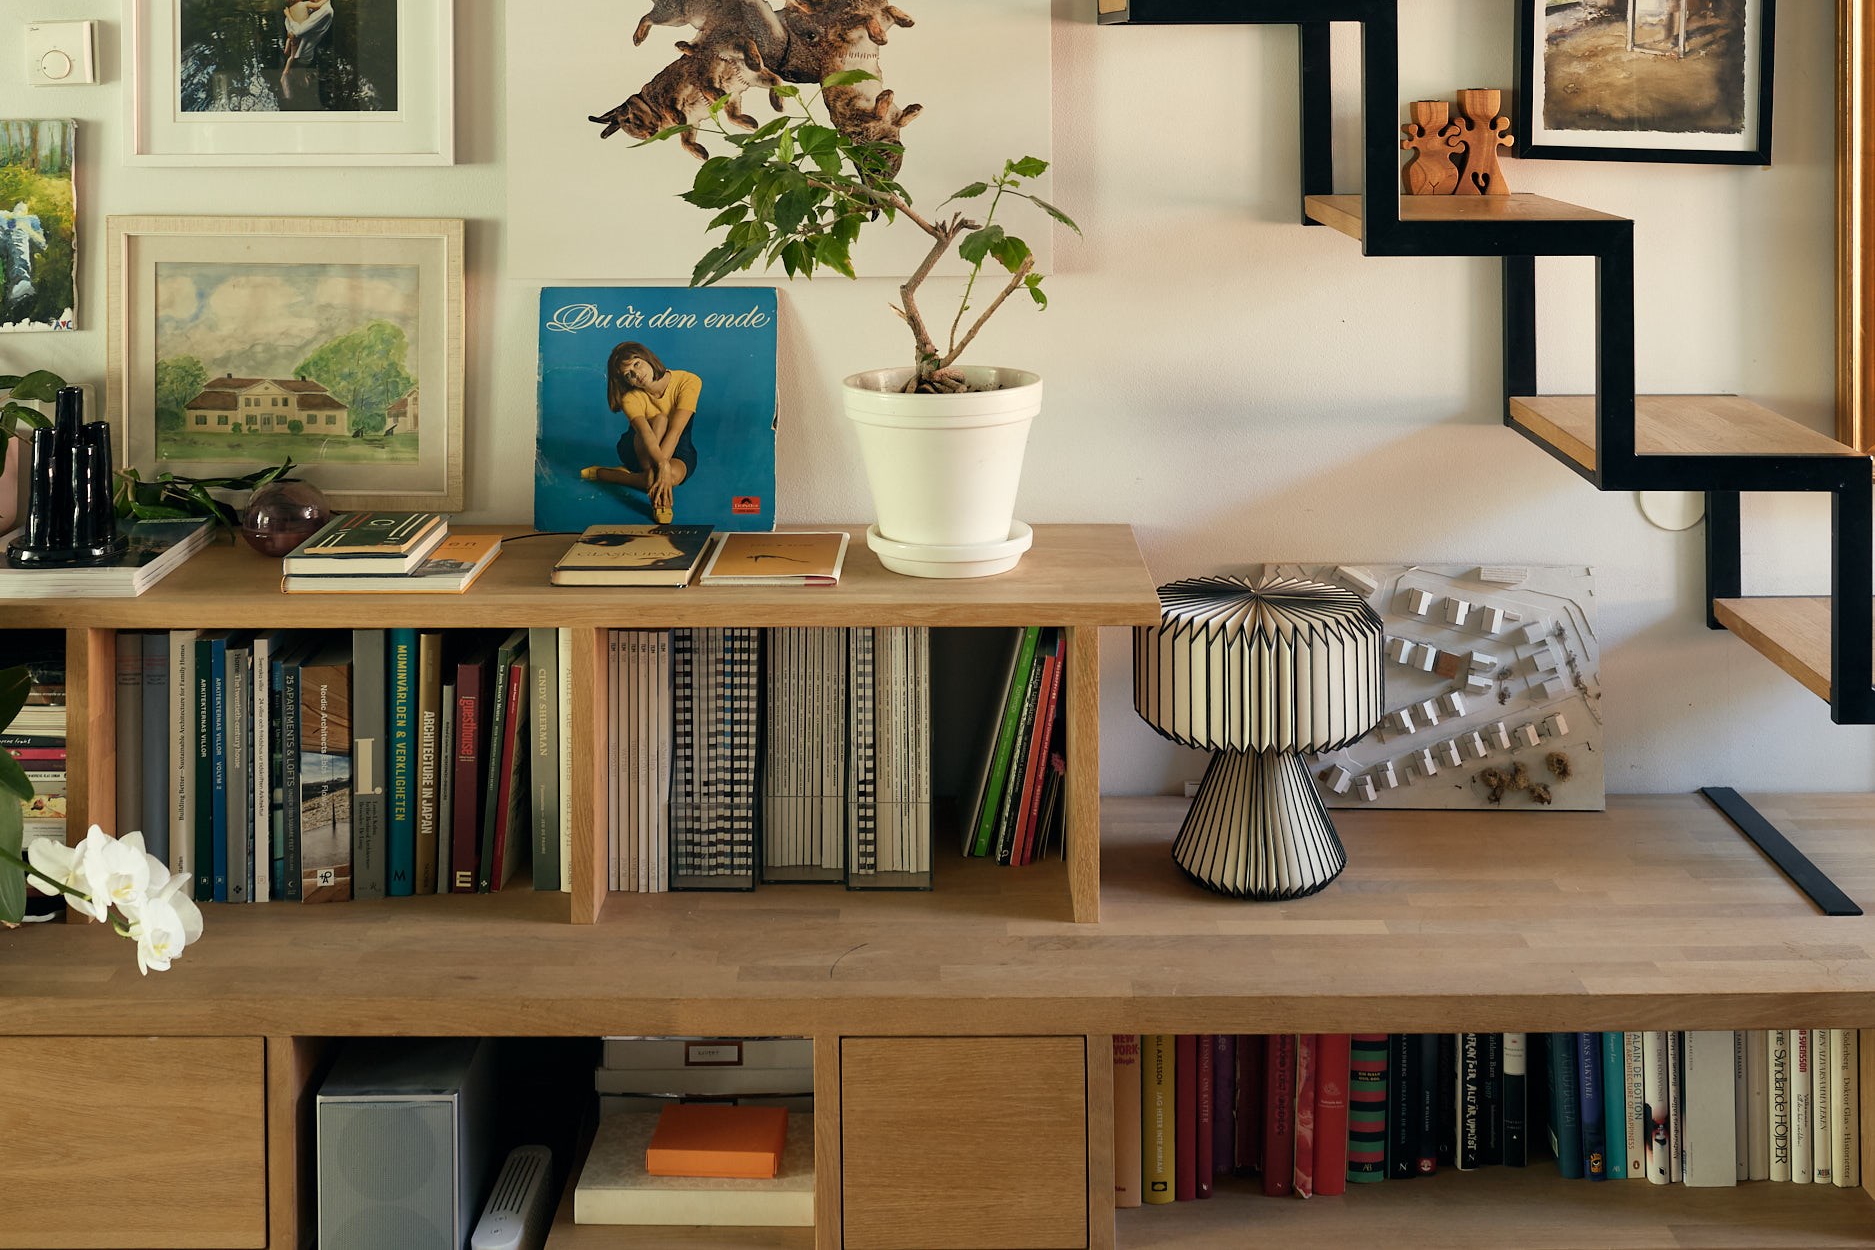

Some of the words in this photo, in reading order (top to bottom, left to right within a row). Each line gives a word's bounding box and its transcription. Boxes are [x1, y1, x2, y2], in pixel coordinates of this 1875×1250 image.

[546, 303, 610, 334] Du
[648, 306, 697, 329] den
[704, 305, 770, 329] ende
[286, 676, 294, 684] 25
[320, 685, 328, 710] Nordic
[396, 645, 409, 726] MUMINVÄRLDEN
[538, 668, 547, 700] CINDY
[286, 687, 295, 748] APARTMENTS
[320, 713, 328, 754] Architects
[458, 699, 477, 756] guesthouse
[538, 703, 548, 756] SHERMAN
[422, 711, 435, 786] ARCHITECTURE
[286, 758, 295, 786] LOFTS
[394, 742, 406, 820] VERKLIGHETEN
[422, 788, 434, 798] IN
[420, 800, 434, 834] JAPAN
[1632, 1034, 1641, 1062] ALAIN
[1798, 1036, 1807, 1072] SVENSSON
[1818, 1030, 1826, 1046] DEN
[1842, 1031, 1851, 1070] Söderberg
[1626, 1049, 1634, 1099] ARCHITECTURE
[1632, 1067, 1642, 1078] DE
[1774, 1050, 1788, 1112] Svindlande
[1819, 1048, 1827, 1104] ALLVARSAMMA
[1466, 1084, 1477, 1103] ALLT
[1633, 1083, 1642, 1120] BOTTON
[1843, 1078, 1851, 1106] Doktor
[1466, 1105, 1479, 1118] ÄR
[1820, 1106, 1828, 1131] LEKEN
[1466, 1119, 1478, 1150] UPPLYST
[1774, 1114, 1788, 1164] HÖJDER
[1844, 1133, 1852, 1179] Historietter
